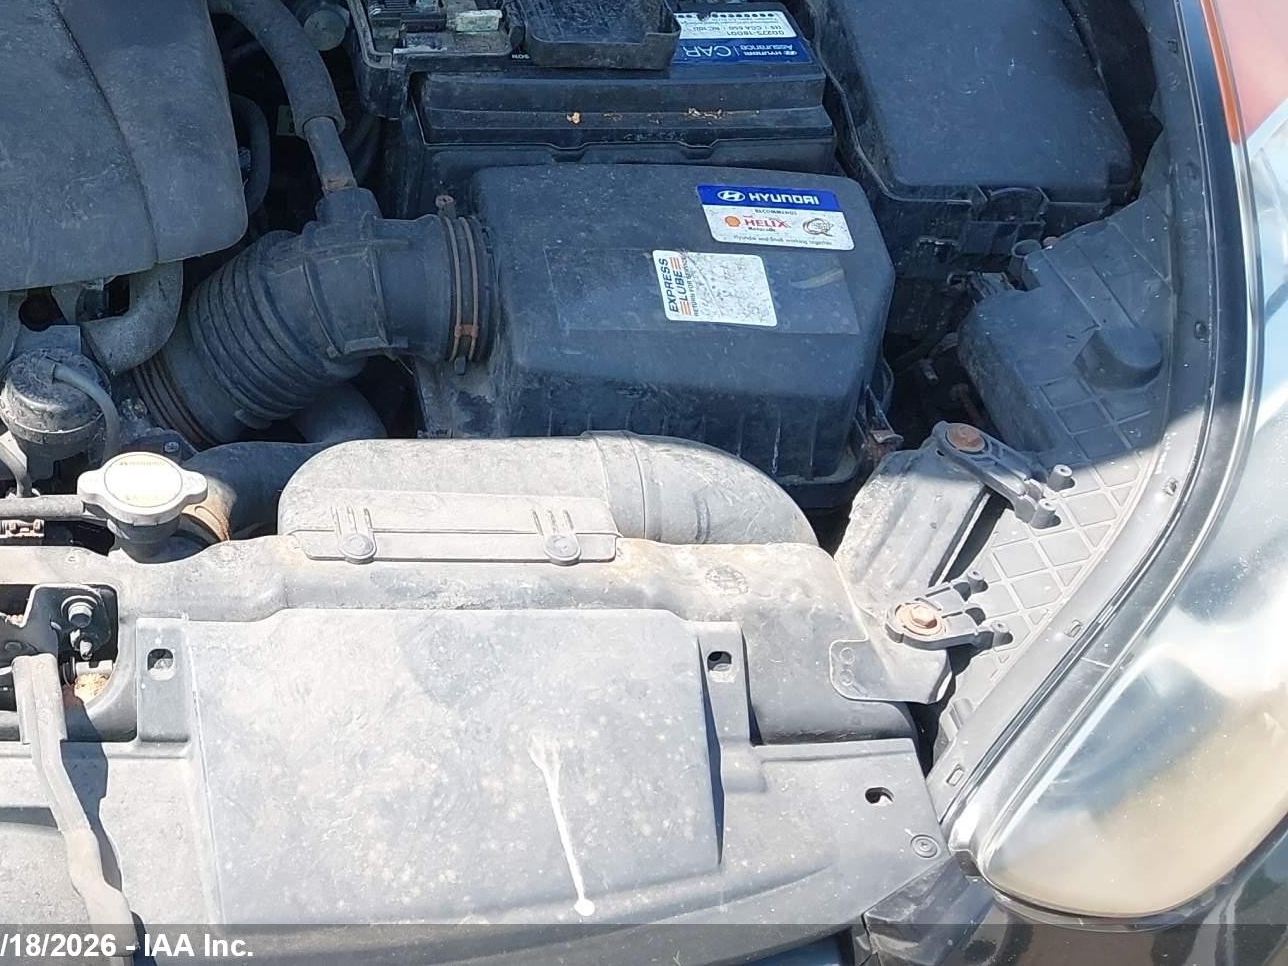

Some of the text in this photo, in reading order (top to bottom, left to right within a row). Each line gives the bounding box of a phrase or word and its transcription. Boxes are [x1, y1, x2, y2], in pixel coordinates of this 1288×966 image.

[682, 45, 732, 57] CAR
[748, 192, 820, 205] HYUNDAI
[744, 218, 789, 229] HELIX
[659, 258, 679, 313] EXPRESS
[673, 270, 689, 302] LUBE
[685, 279, 695, 292] FOR
[689, 292, 699, 317] RETURN
